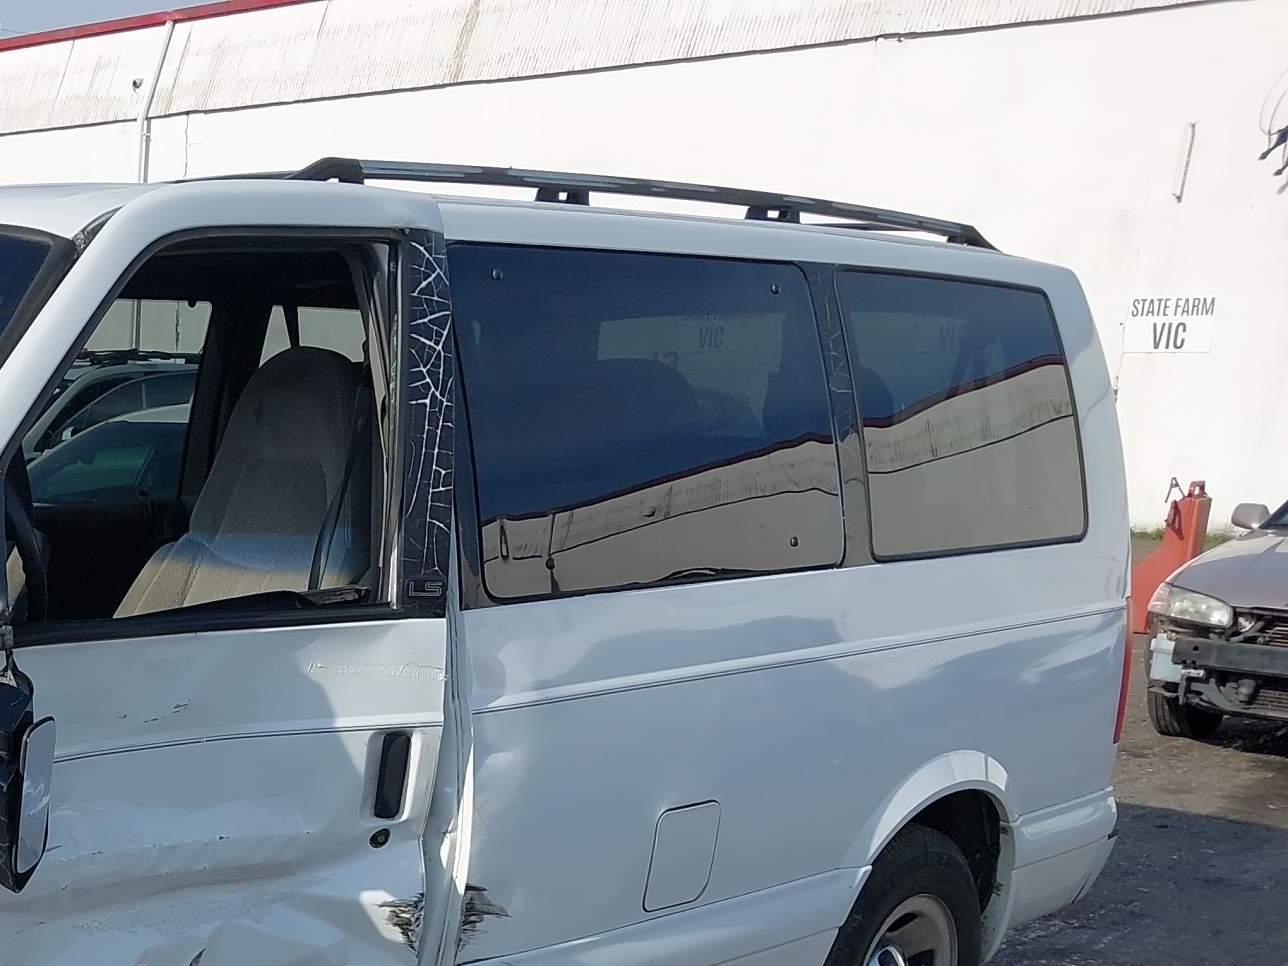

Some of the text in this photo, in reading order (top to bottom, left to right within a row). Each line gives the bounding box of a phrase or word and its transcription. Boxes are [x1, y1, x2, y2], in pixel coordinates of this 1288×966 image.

[1131, 297, 1216, 318] STATE FARM
[698, 324, 725, 349] VIC
[1152, 322, 1187, 350] VIC
[408, 581, 444, 597] LS
